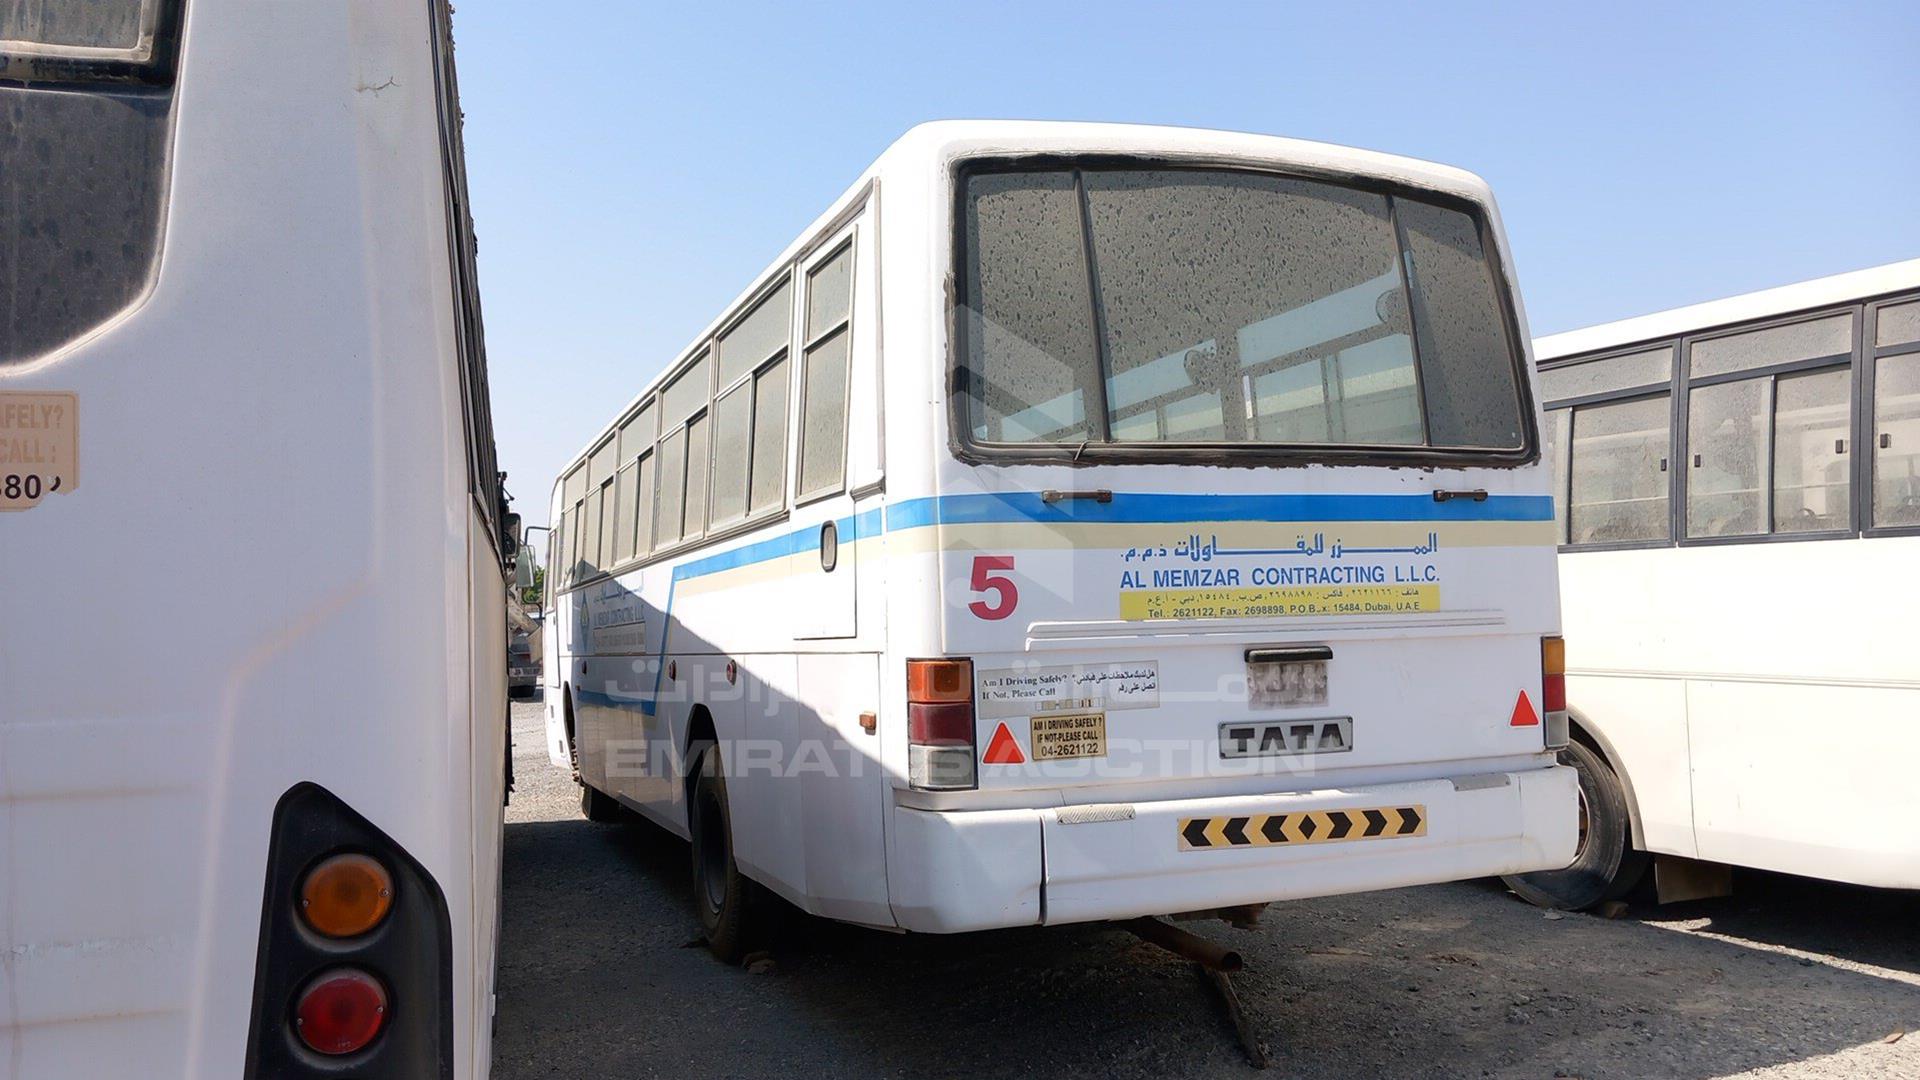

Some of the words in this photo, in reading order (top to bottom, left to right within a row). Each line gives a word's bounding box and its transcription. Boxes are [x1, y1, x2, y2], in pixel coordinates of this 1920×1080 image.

[1120, 571, 1146, 588] AL
[1153, 568, 1240, 588] MEMZAR
[1252, 565, 1385, 586] CONTRACTING
[1395, 565, 1440, 582] L.L.C.
[967, 556, 1018, 620] 5
[1172, 607, 1217, 618] 2621122,
[1220, 606, 1241, 616] Fax:
[1333, 602, 1363, 612] 15484,
[1364, 601, 1394, 612] Dubai,
[982, 680, 997, 688] Am
[1005, 676, 1038, 688] Driving
[1039, 674, 1068, 686] Safely?
[1012, 689, 1037, 699] Please
[1038, 687, 1056, 697] Call
[1033, 721, 1043, 731] AM
[1048, 719, 1074, 730] DRIVING
[1074, 717, 1097, 728] SAFELY
[1036, 734, 1043, 743] IF
[1082, 730, 1098, 740] CALL
[1229, 723, 1345, 753] TATA
[1041, 742, 1099, 757] 04-2621122
